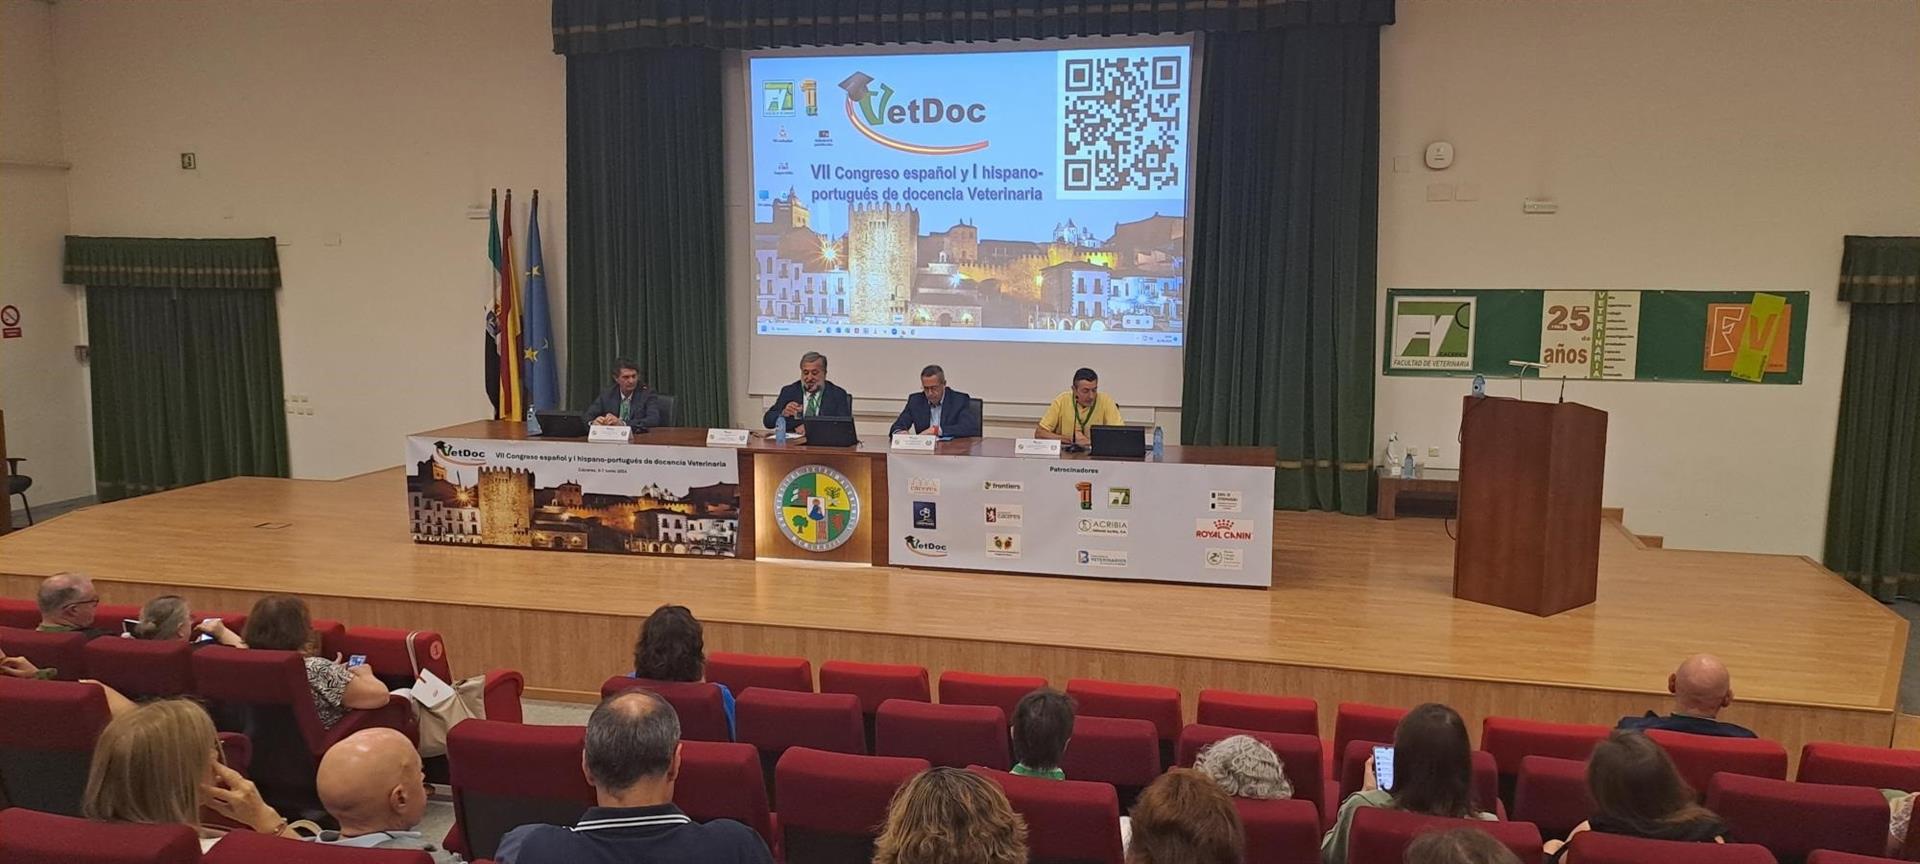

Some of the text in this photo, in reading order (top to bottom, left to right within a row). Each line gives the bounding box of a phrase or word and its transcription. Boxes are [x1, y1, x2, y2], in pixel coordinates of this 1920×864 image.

[859, 83, 986, 125] VetDoc
[811, 164, 830, 180] VII
[835, 166, 899, 183] Congreso
[903, 166, 956, 183] español
[960, 169, 968, 183] y
[982, 166, 1044, 182] hispano-
[812, 187, 1042, 203] portugués de docencia Veterinaria
[1547, 304, 1590, 331] 25
[1544, 343, 1588, 364] años
[442, 444, 486, 457] VetDoc
[506, 453, 538, 461] Congreso
[539, 454, 567, 462] español
[1049, 466, 1099, 474] Patrocinadores
[992, 481, 1021, 490] frontiers
[1092, 520, 1127, 529] ACRIBIA
[1196, 530, 1251, 539] ROYAL CANIN
[912, 539, 947, 550] VetDoc
